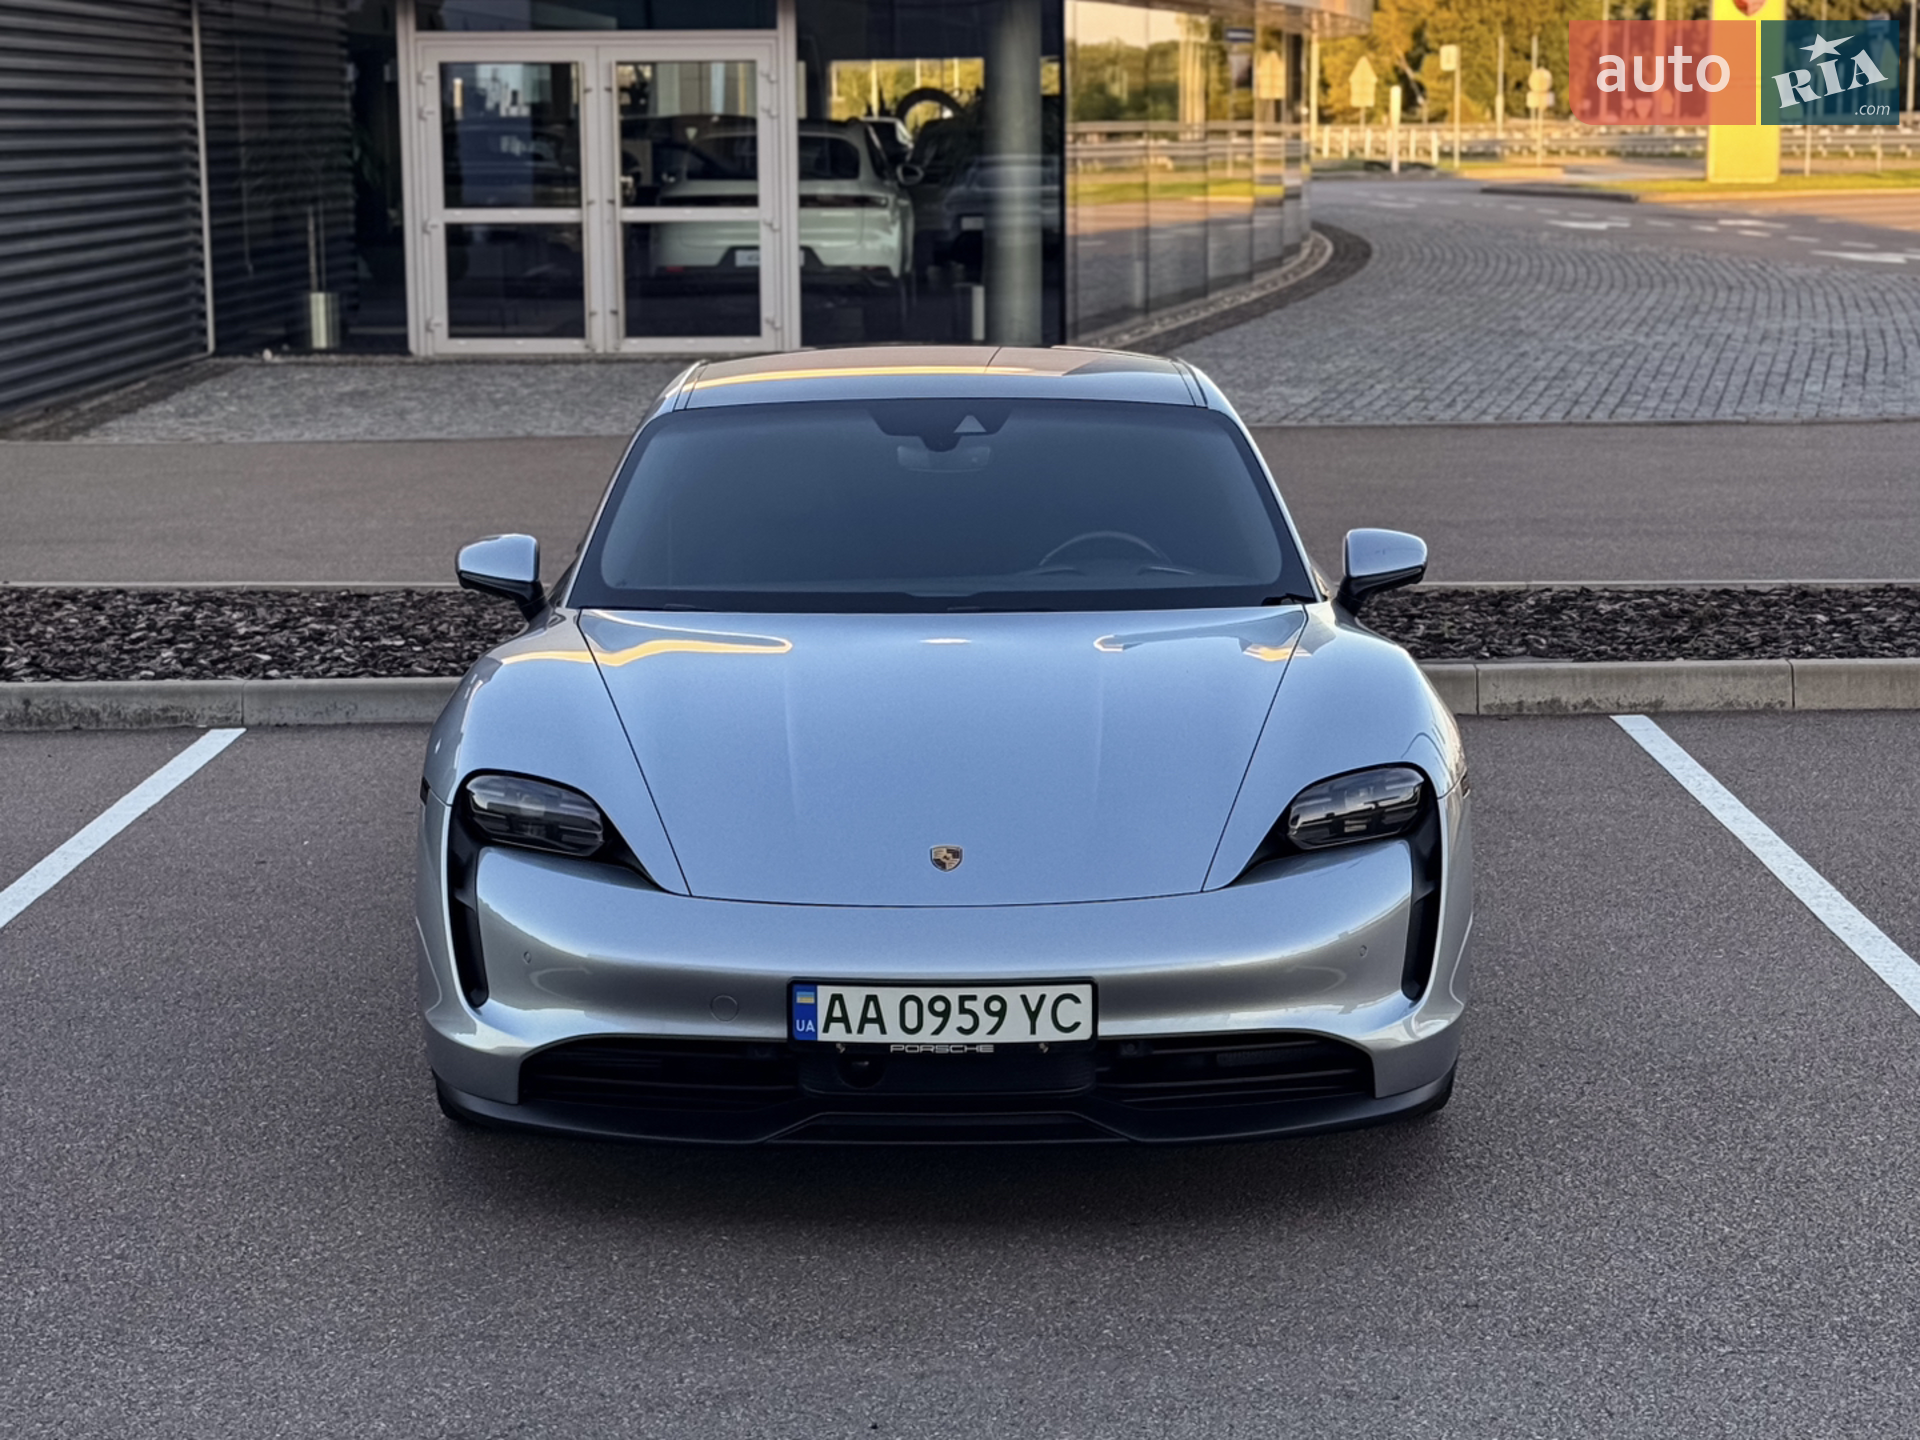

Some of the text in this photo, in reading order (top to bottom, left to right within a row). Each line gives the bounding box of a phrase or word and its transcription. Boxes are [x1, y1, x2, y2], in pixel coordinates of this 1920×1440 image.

[822, 993, 1082, 1035] AA 0959 YC
[796, 1019, 815, 1032] UA
[890, 1044, 994, 1053] PORSCHE
